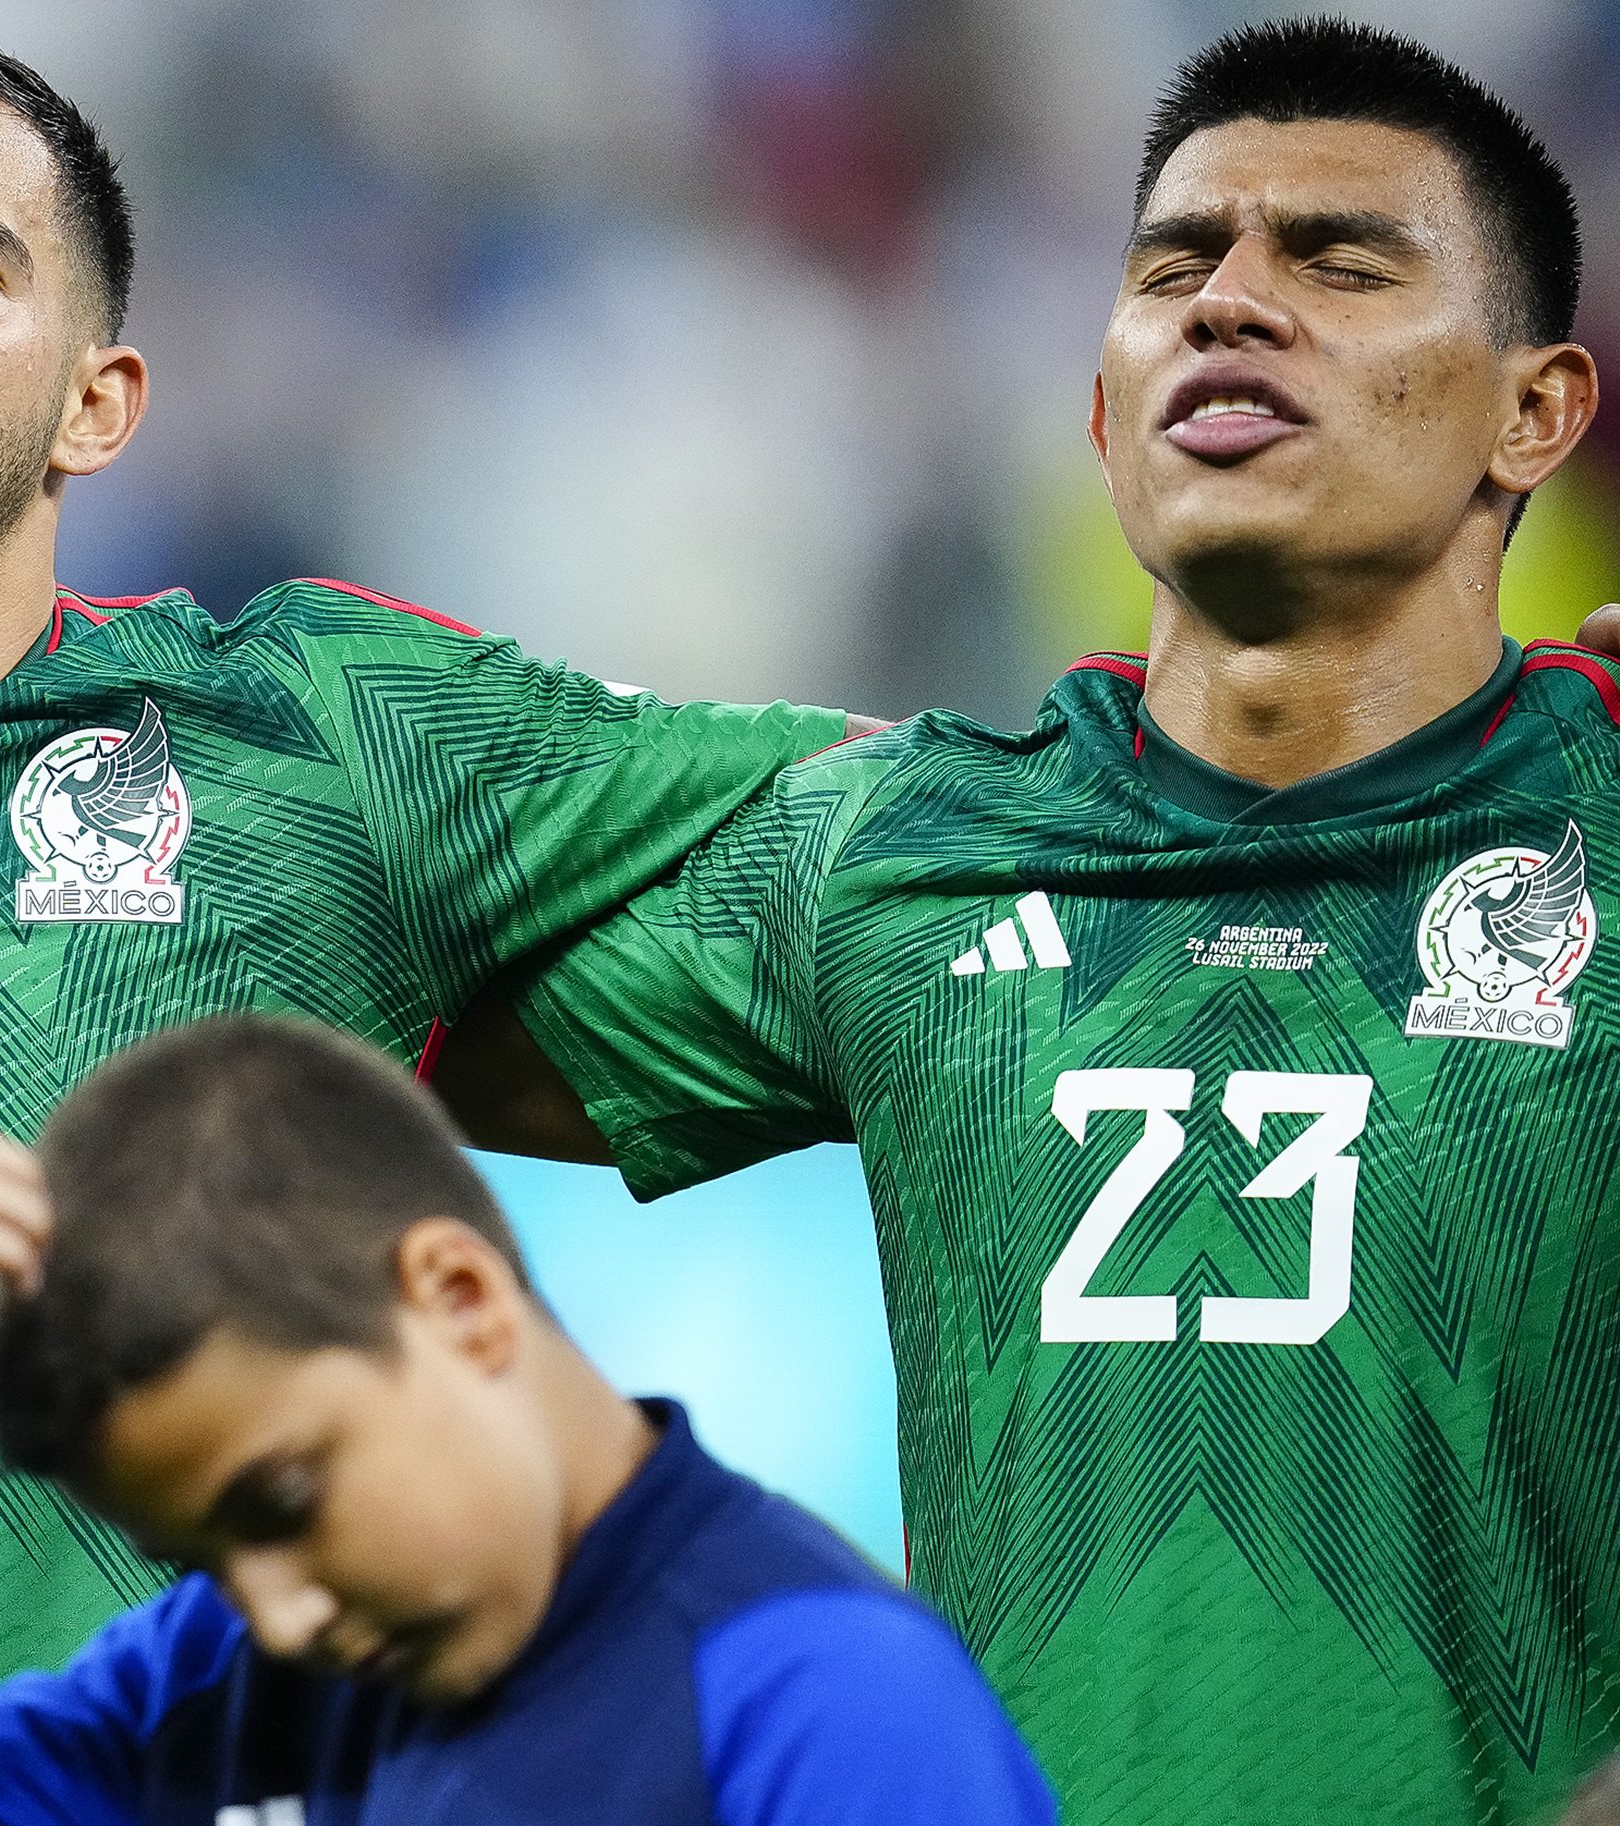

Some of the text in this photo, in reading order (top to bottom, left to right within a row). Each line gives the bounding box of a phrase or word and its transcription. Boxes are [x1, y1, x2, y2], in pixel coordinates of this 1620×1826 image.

[25, 880, 175, 916] MÉXICO
[1184, 937, 1328, 956] 26 NOVEMBER 2022
[1219, 925, 1302, 942] ARGENTINA
[1192, 951, 1313, 970] LUSAIL STADIUM
[1411, 997, 1563, 1039] MÉXICO
[1040, 1067, 1374, 1345] 23
